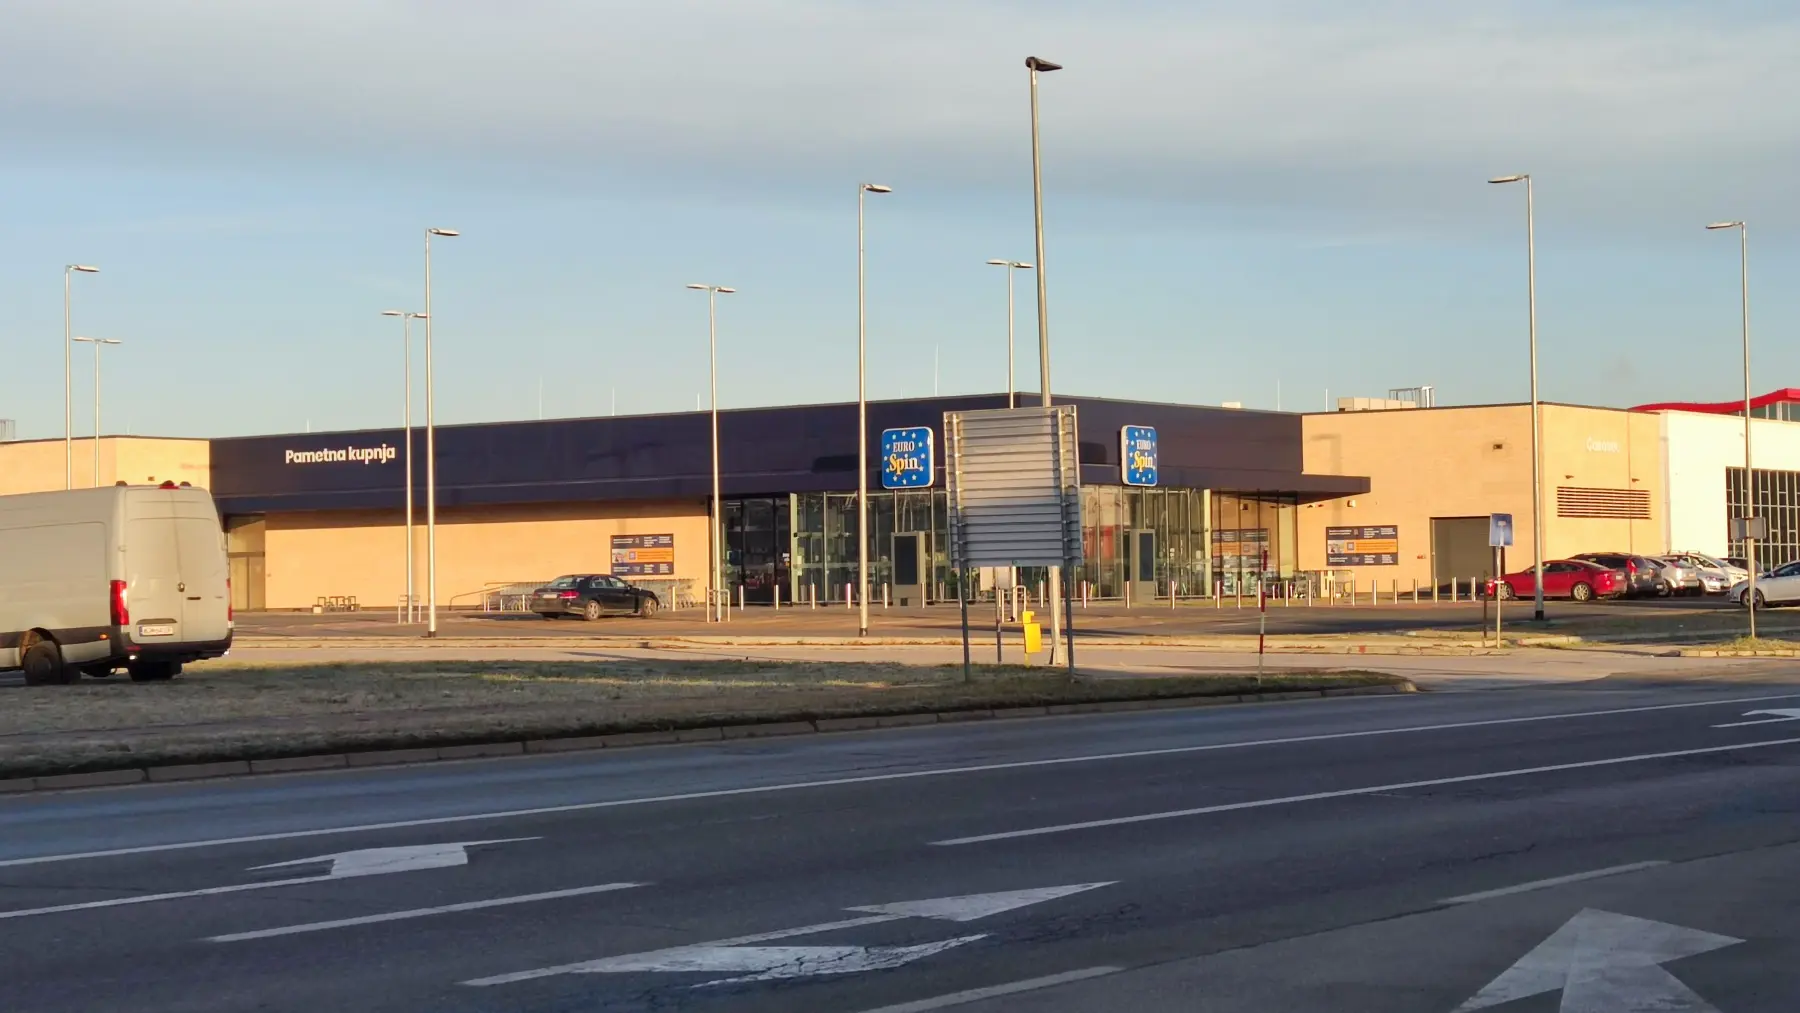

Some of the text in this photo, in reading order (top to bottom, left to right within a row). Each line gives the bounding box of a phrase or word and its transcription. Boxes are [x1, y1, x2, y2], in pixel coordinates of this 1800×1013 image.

[285, 443, 396, 465] Pametna kupnja
[892, 440, 915, 453] EURO
[889, 453, 919, 476] Spin
[1134, 450, 1153, 473] Spin
